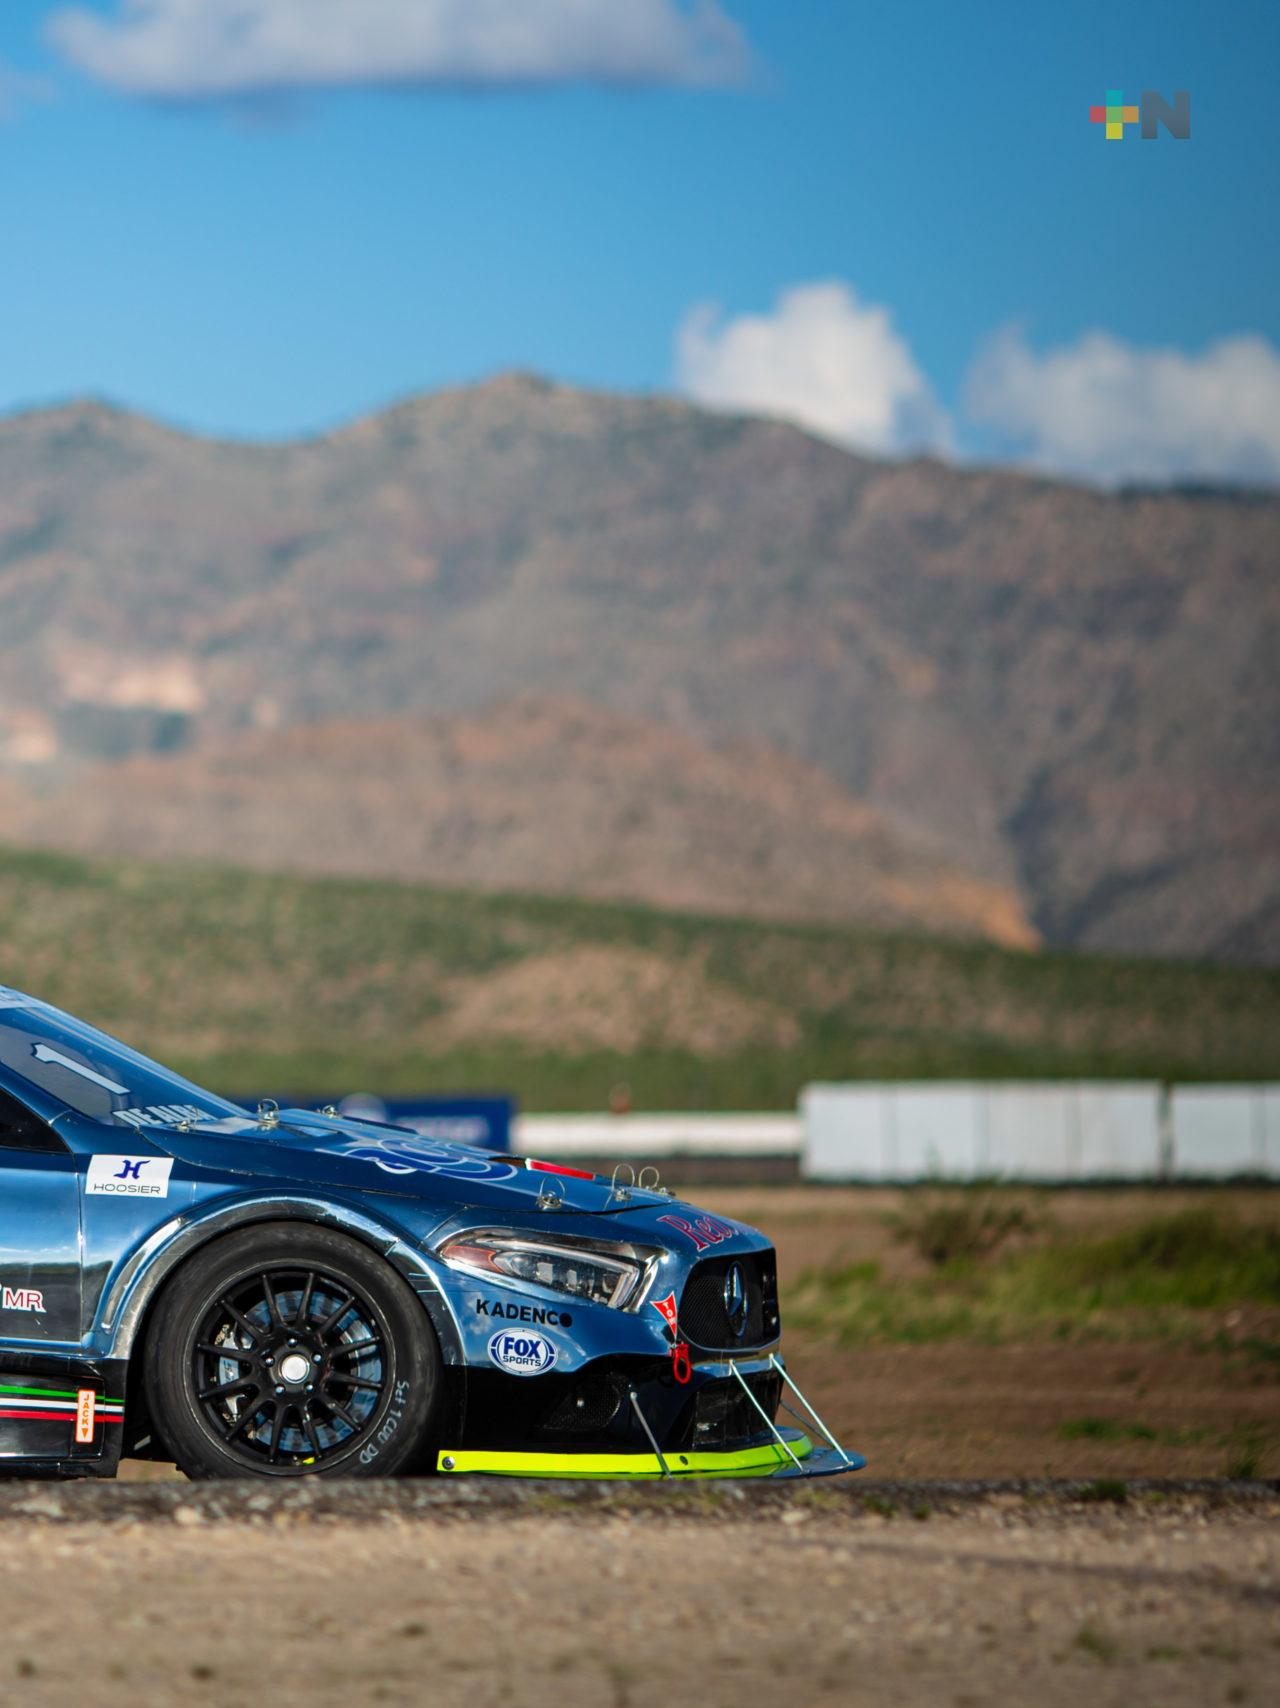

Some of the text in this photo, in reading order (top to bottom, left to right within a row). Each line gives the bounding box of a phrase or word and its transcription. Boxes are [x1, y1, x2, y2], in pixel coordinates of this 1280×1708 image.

[32, 1042, 130, 1094] 1
[94, 1183, 161, 1194] HOOSIER
[2, 1286, 47, 1313] MR
[503, 1336, 541, 1359] FOX
[502, 1355, 542, 1367] SPORTS
[81, 1393, 90, 1425] JACK
